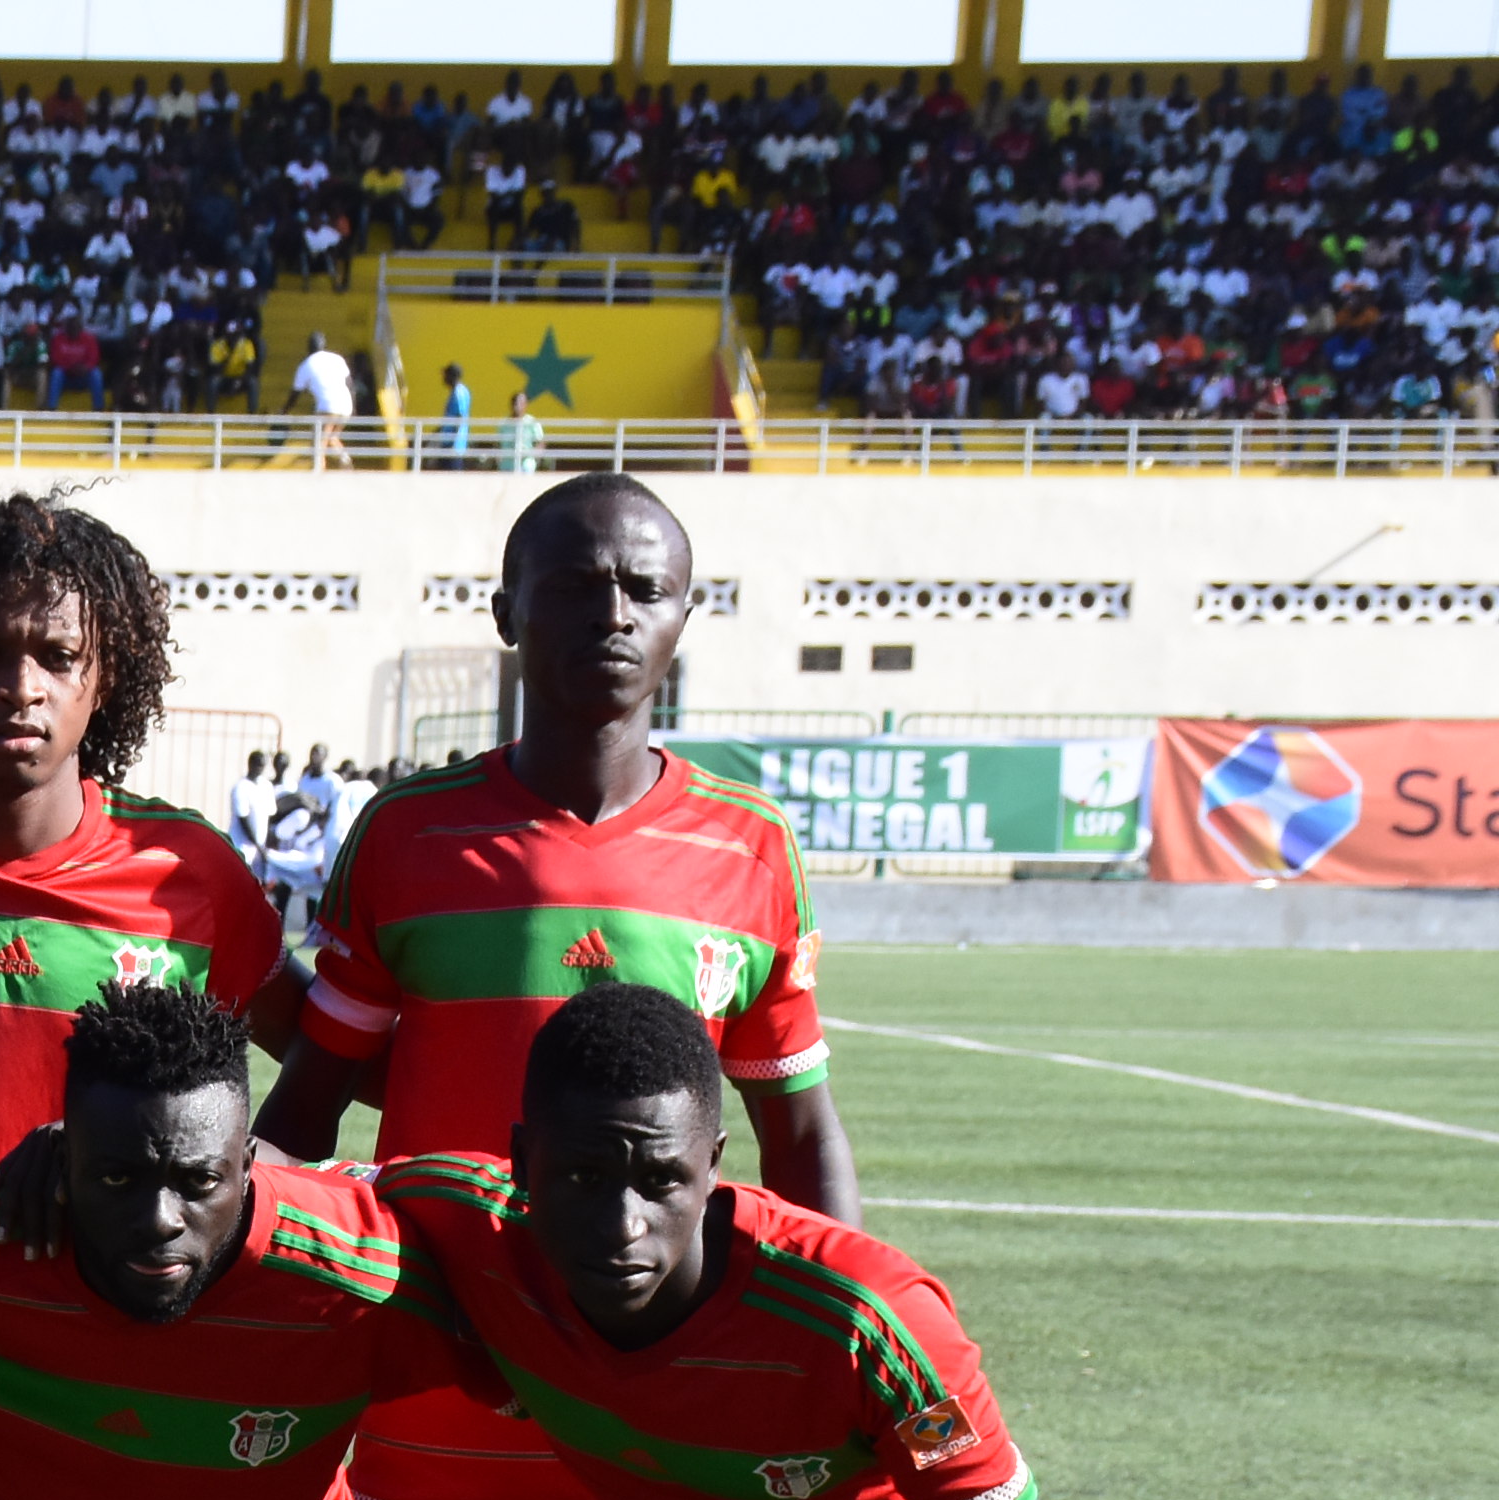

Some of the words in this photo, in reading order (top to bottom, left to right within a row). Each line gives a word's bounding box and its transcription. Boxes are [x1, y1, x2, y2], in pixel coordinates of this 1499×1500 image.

[760, 748, 925, 800] LIGUE
[939, 751, 970, 800] 1
[793, 801, 994, 851] ENEGAL
[1073, 811, 1127, 838] LSFP
